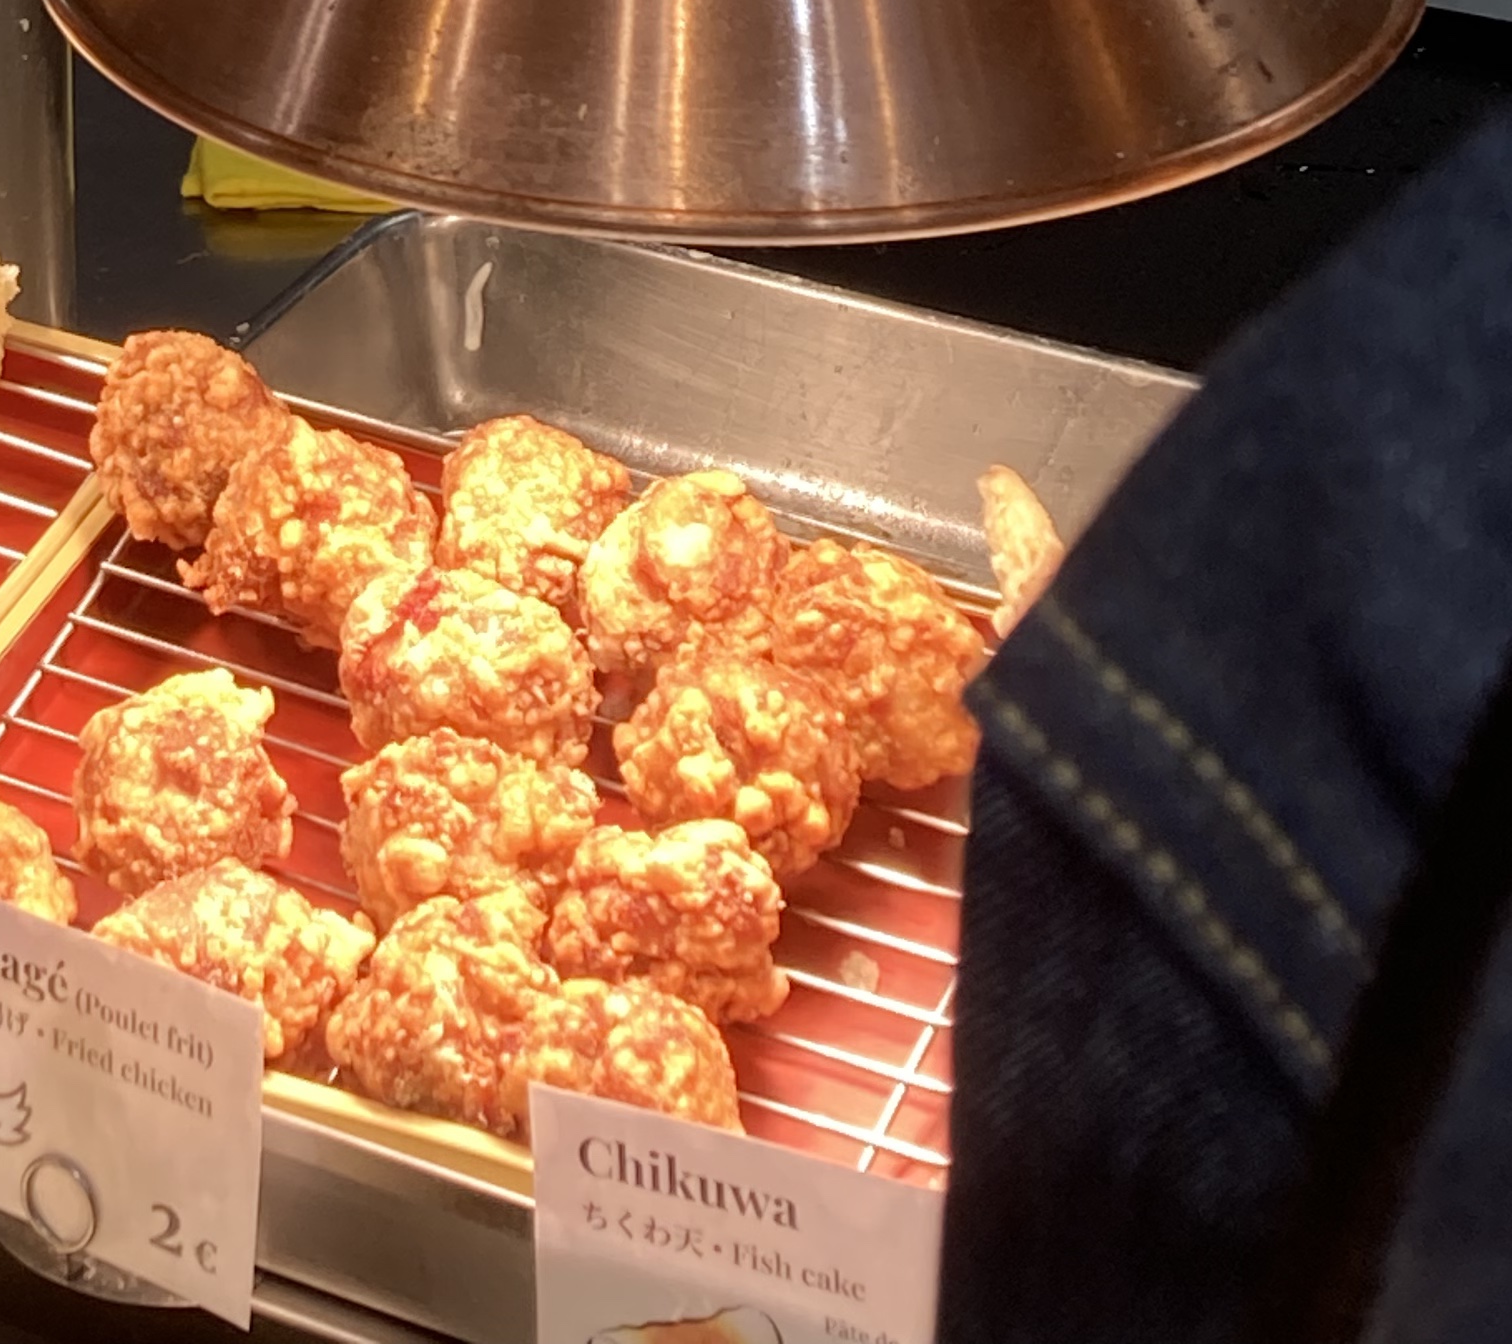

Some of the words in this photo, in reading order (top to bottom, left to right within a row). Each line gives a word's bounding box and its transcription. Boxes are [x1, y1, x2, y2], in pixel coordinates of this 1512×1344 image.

[52, 1027, 114, 1085] Fried
[120, 1061, 214, 1119] chicken
[75, 987, 160, 1045] (Poulet
[167, 1024, 214, 1071] frit)
[579, 1136, 799, 1232] Chikuwa
[583, 1201, 704, 1259] ちくわ天
[733, 1242, 792, 1281] Fish
[801, 1267, 866, 1302] cake
